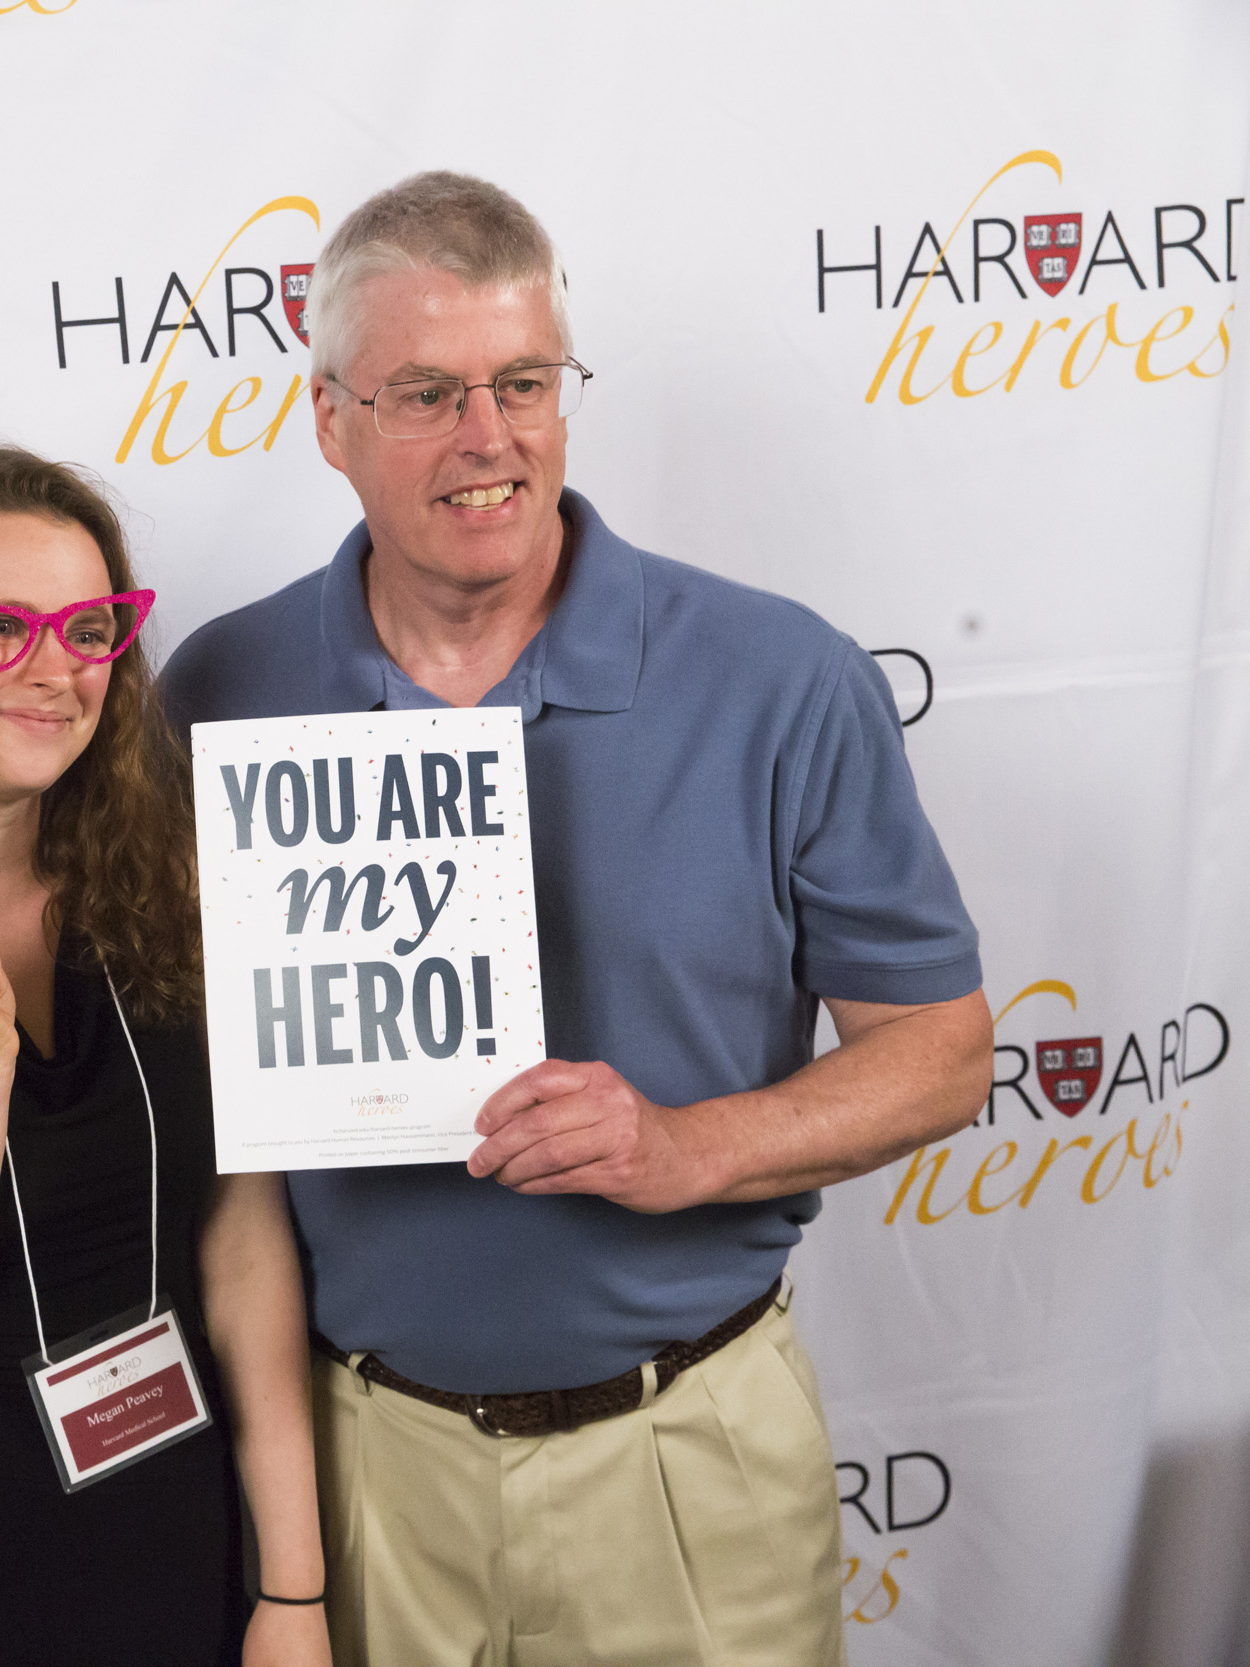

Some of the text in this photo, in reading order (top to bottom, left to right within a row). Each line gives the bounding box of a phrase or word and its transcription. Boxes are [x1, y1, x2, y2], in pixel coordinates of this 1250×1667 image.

[865, 150, 1235, 405] heroes
[219, 750, 505, 850] YOU ARE
[276, 859, 457, 957] my
[253, 955, 497, 1069] HERO!
[86, 1385, 164, 1428] Megan Peavey
